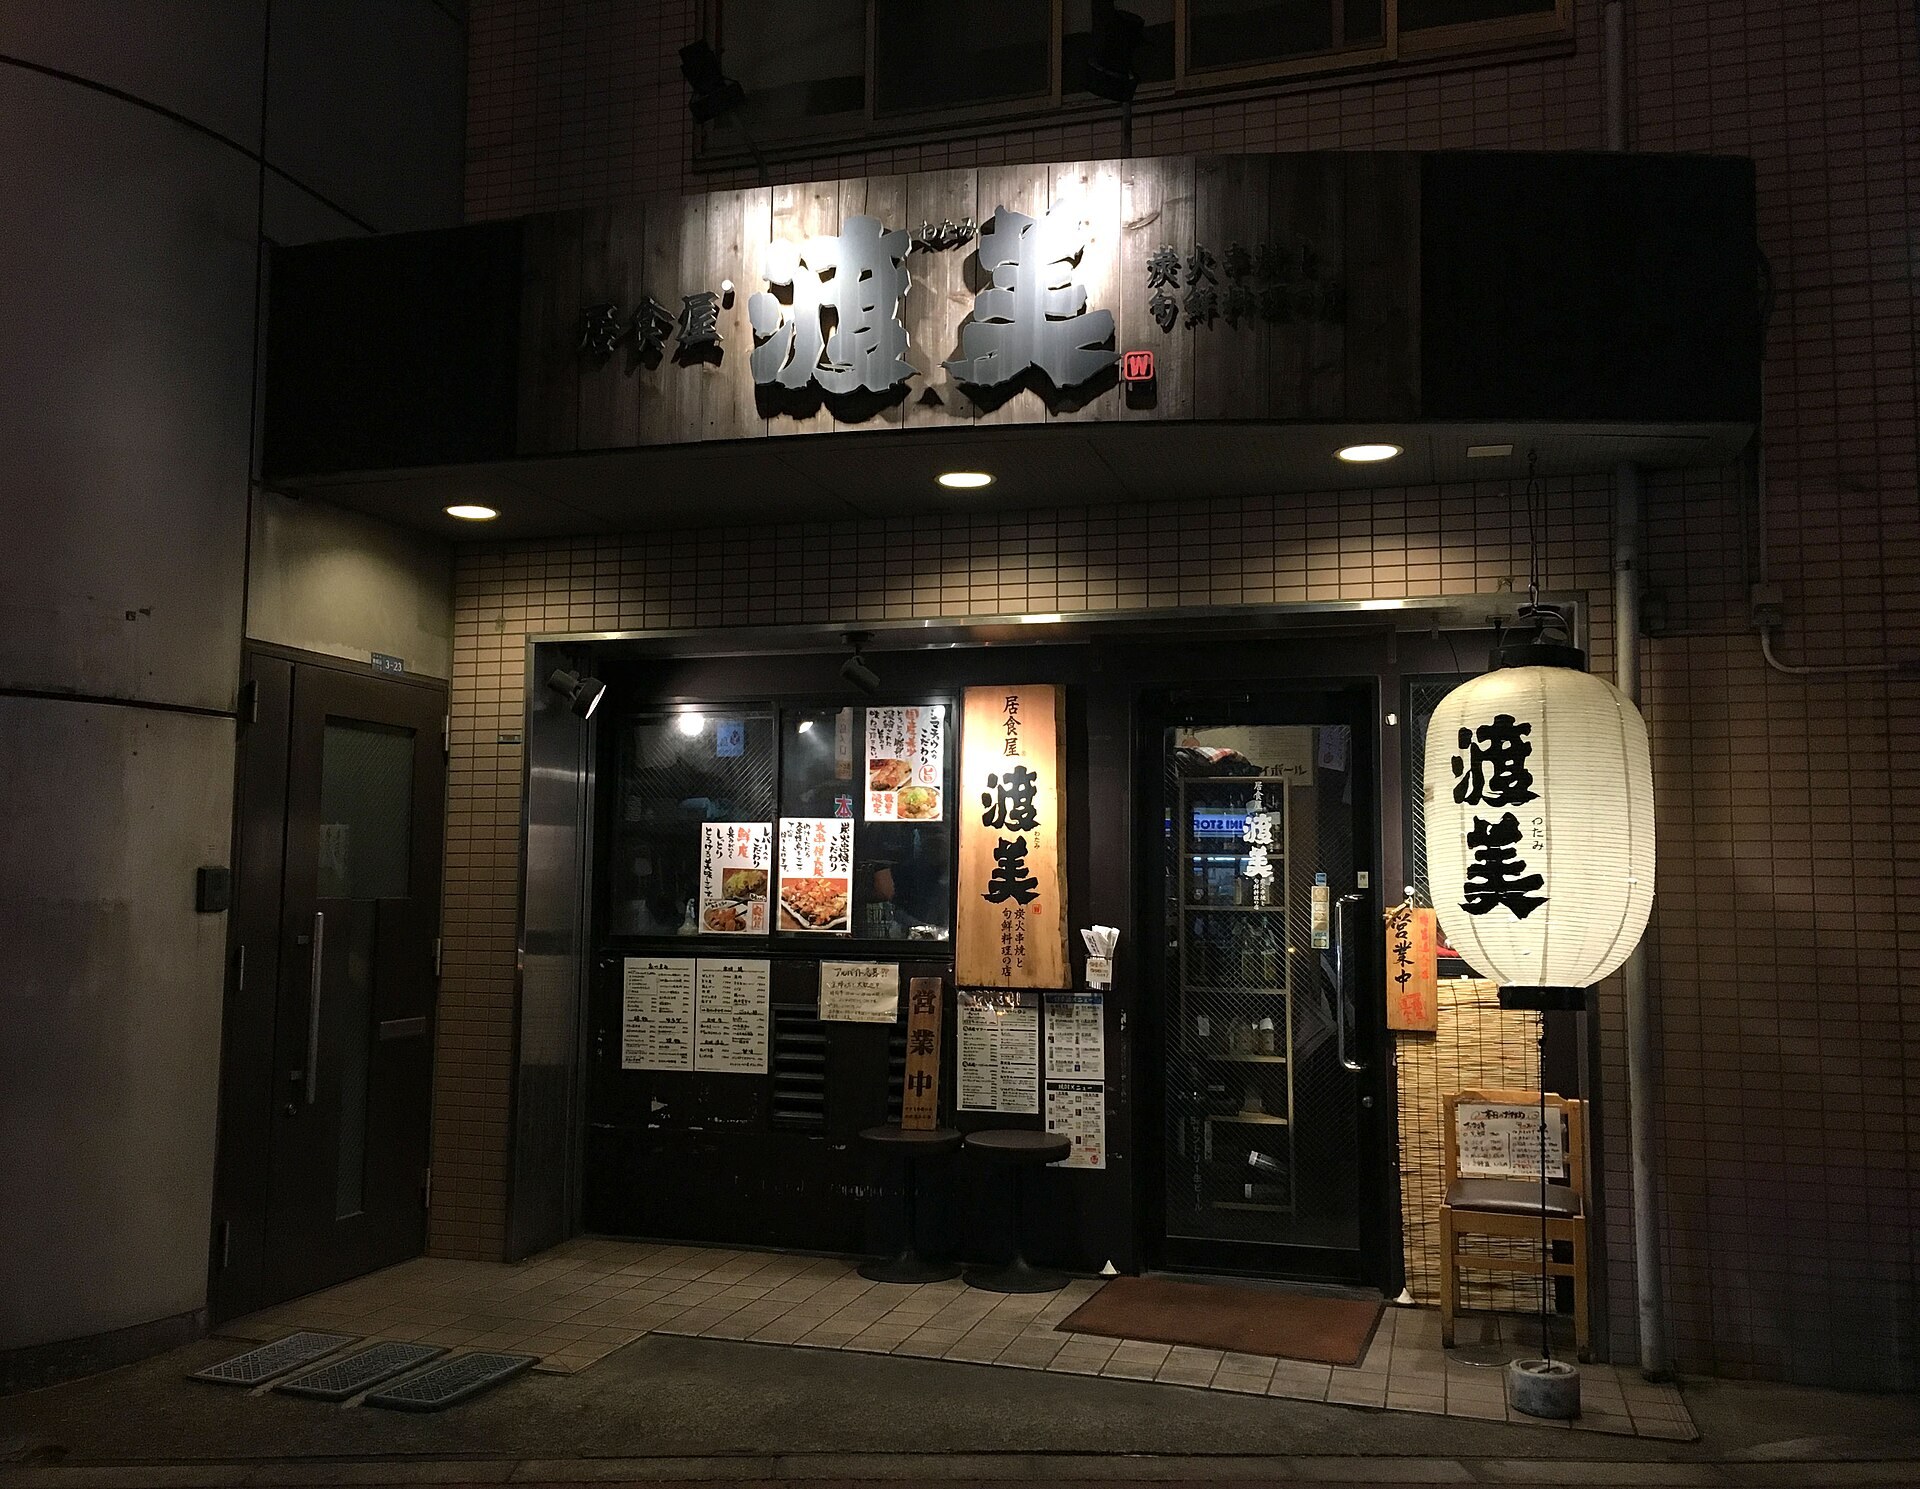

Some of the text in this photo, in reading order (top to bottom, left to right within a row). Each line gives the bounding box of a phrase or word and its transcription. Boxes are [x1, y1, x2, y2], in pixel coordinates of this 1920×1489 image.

[918, 217, 979, 242] わたみ
[580, 291, 724, 352] 居食屋
[750, 204, 1122, 393] 渡美
[920, 728, 930, 765] こだわり
[1003, 695, 1021, 757] 居食屋
[716, 827, 725, 859] しっとり
[980, 765, 1042, 906] 渡美
[1033, 831, 1041, 850] わたみ
[1242, 813, 1274, 878] 渡美
[1451, 714, 1551, 920] 渡美
[753, 838, 763, 868] こだわり
[829, 836, 838, 872] こだわり
[1001, 907, 1012, 977] 旬鮮料理の店
[1014, 907, 1026, 968] 炭火串焼と
[1391, 912, 1416, 994] 営業中
[908, 989, 937, 1097] 営業中
